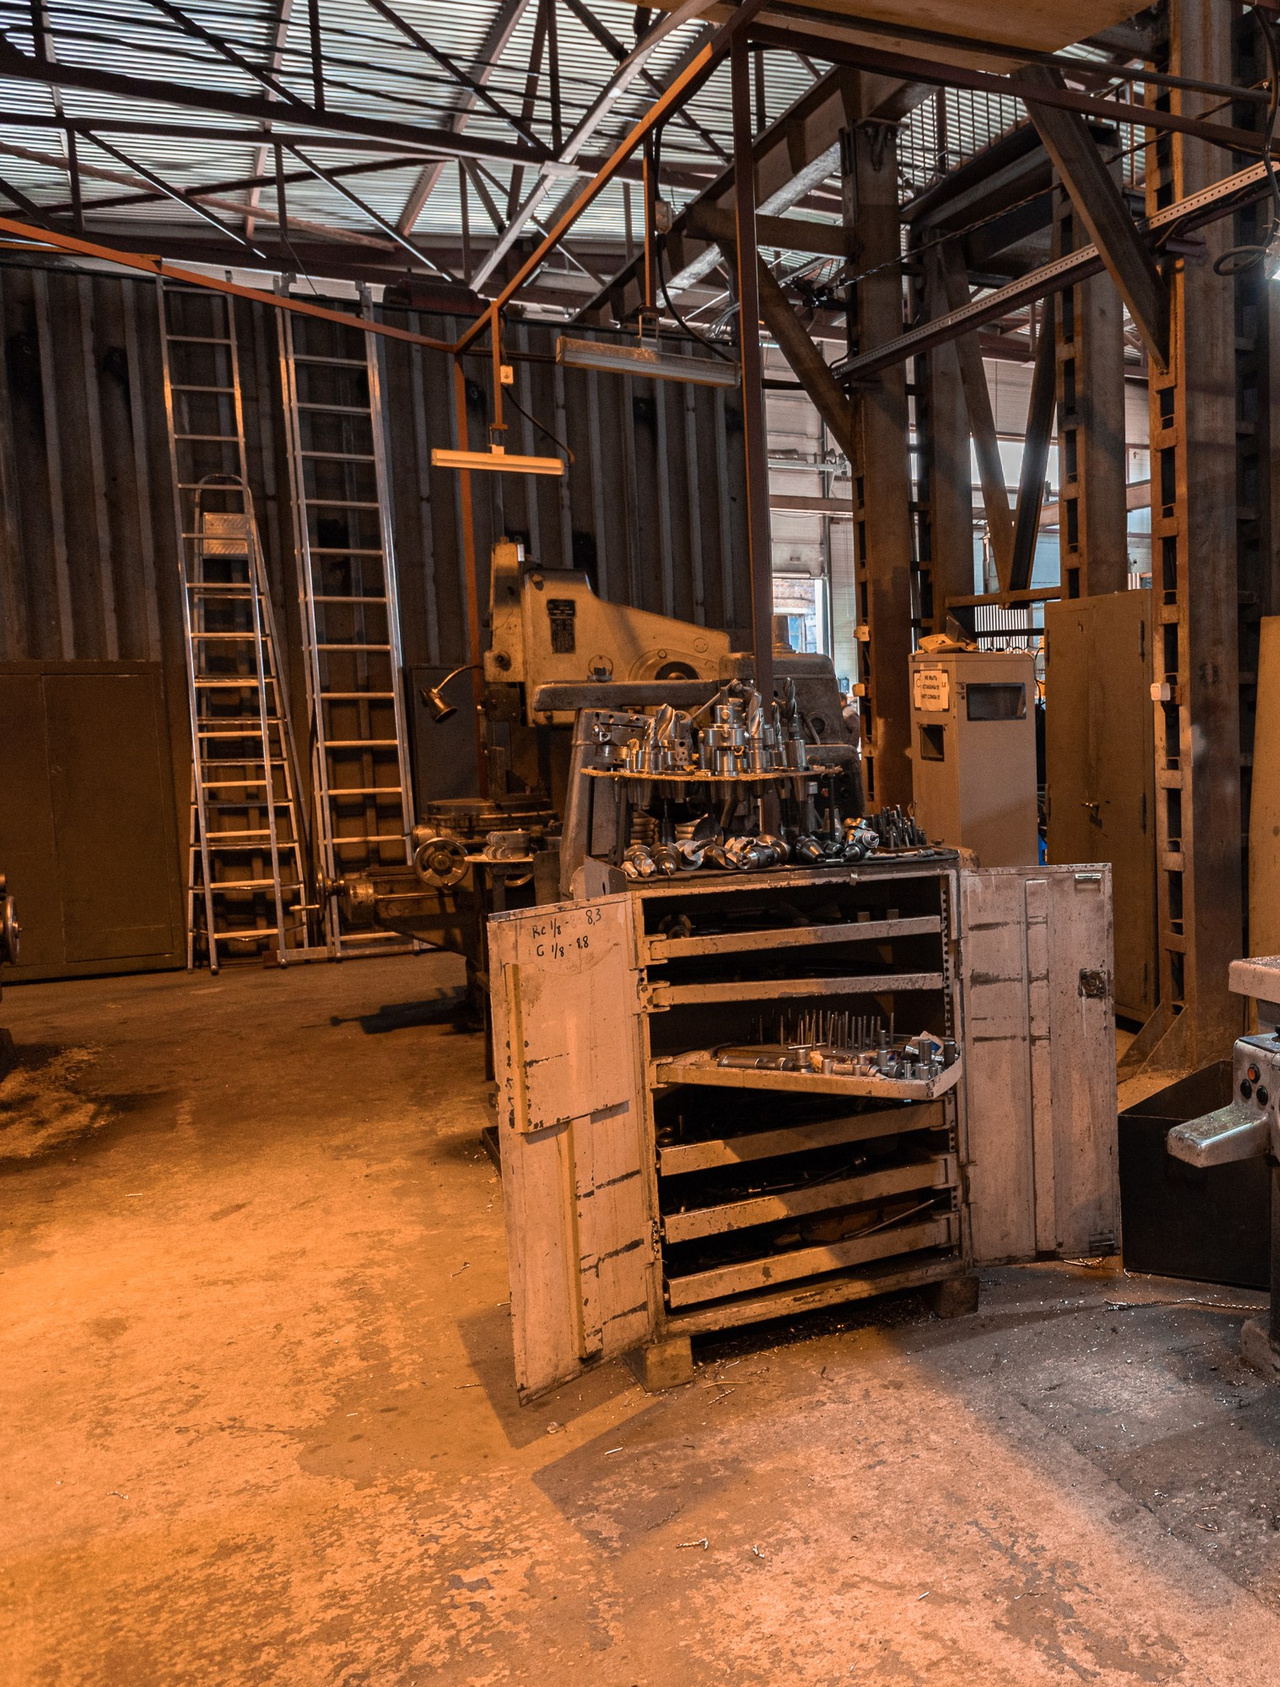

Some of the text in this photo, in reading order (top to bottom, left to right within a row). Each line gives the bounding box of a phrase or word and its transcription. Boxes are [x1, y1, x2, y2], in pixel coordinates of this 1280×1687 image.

[550, 918, 561, 938] 1/8
[536, 944, 544, 957] G
[551, 943, 565, 959] 1/8
